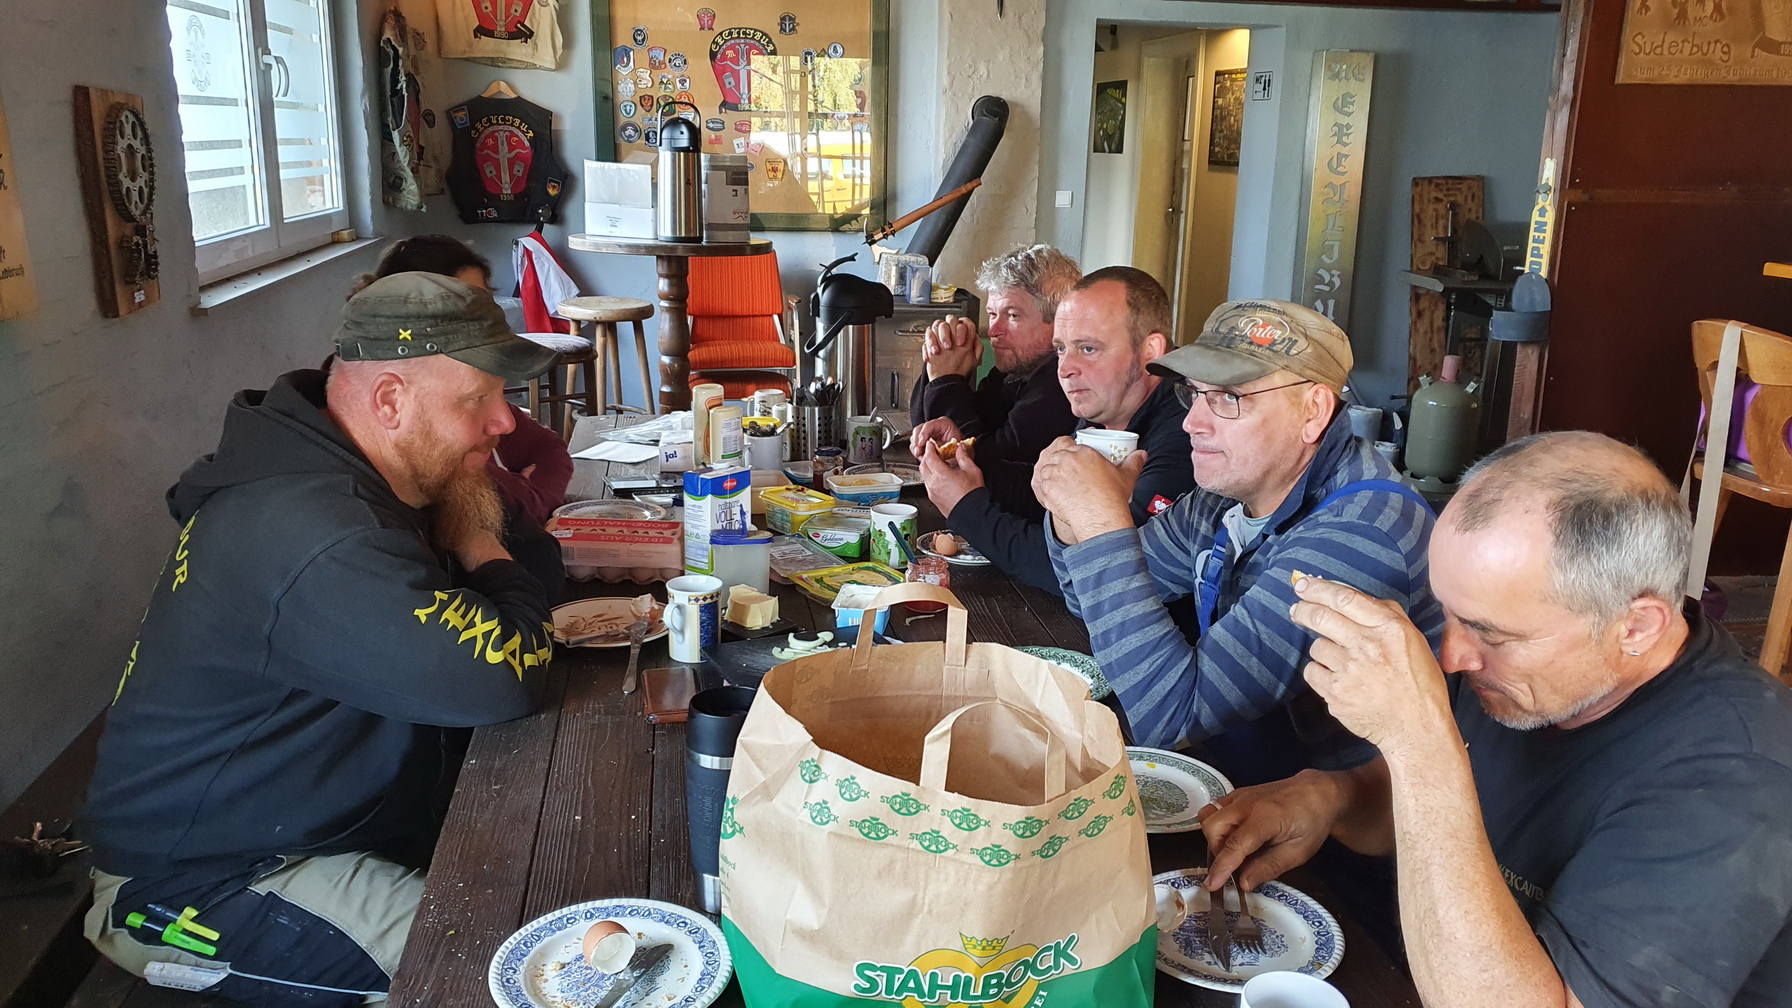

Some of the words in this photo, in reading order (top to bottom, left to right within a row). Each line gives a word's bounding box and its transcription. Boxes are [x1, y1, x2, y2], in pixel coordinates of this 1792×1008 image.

[1632, 31, 1731, 63] Suderburg
[1528, 219, 1549, 274] OPEN
[1235, 315, 1285, 340] Porter
[664, 450, 678, 462] ja!
[567, 520, 669, 529] BODENHALTUNG
[880, 795, 930, 812] STAHLBOCK
[848, 819, 898, 837] STAHLBOCK
[940, 808, 991, 828] STAHLBOCK
[909, 832, 959, 852] STAHLBOCK
[969, 847, 1021, 861] STAHLBOCK
[851, 933, 1082, 1004] STAHLBOCK
